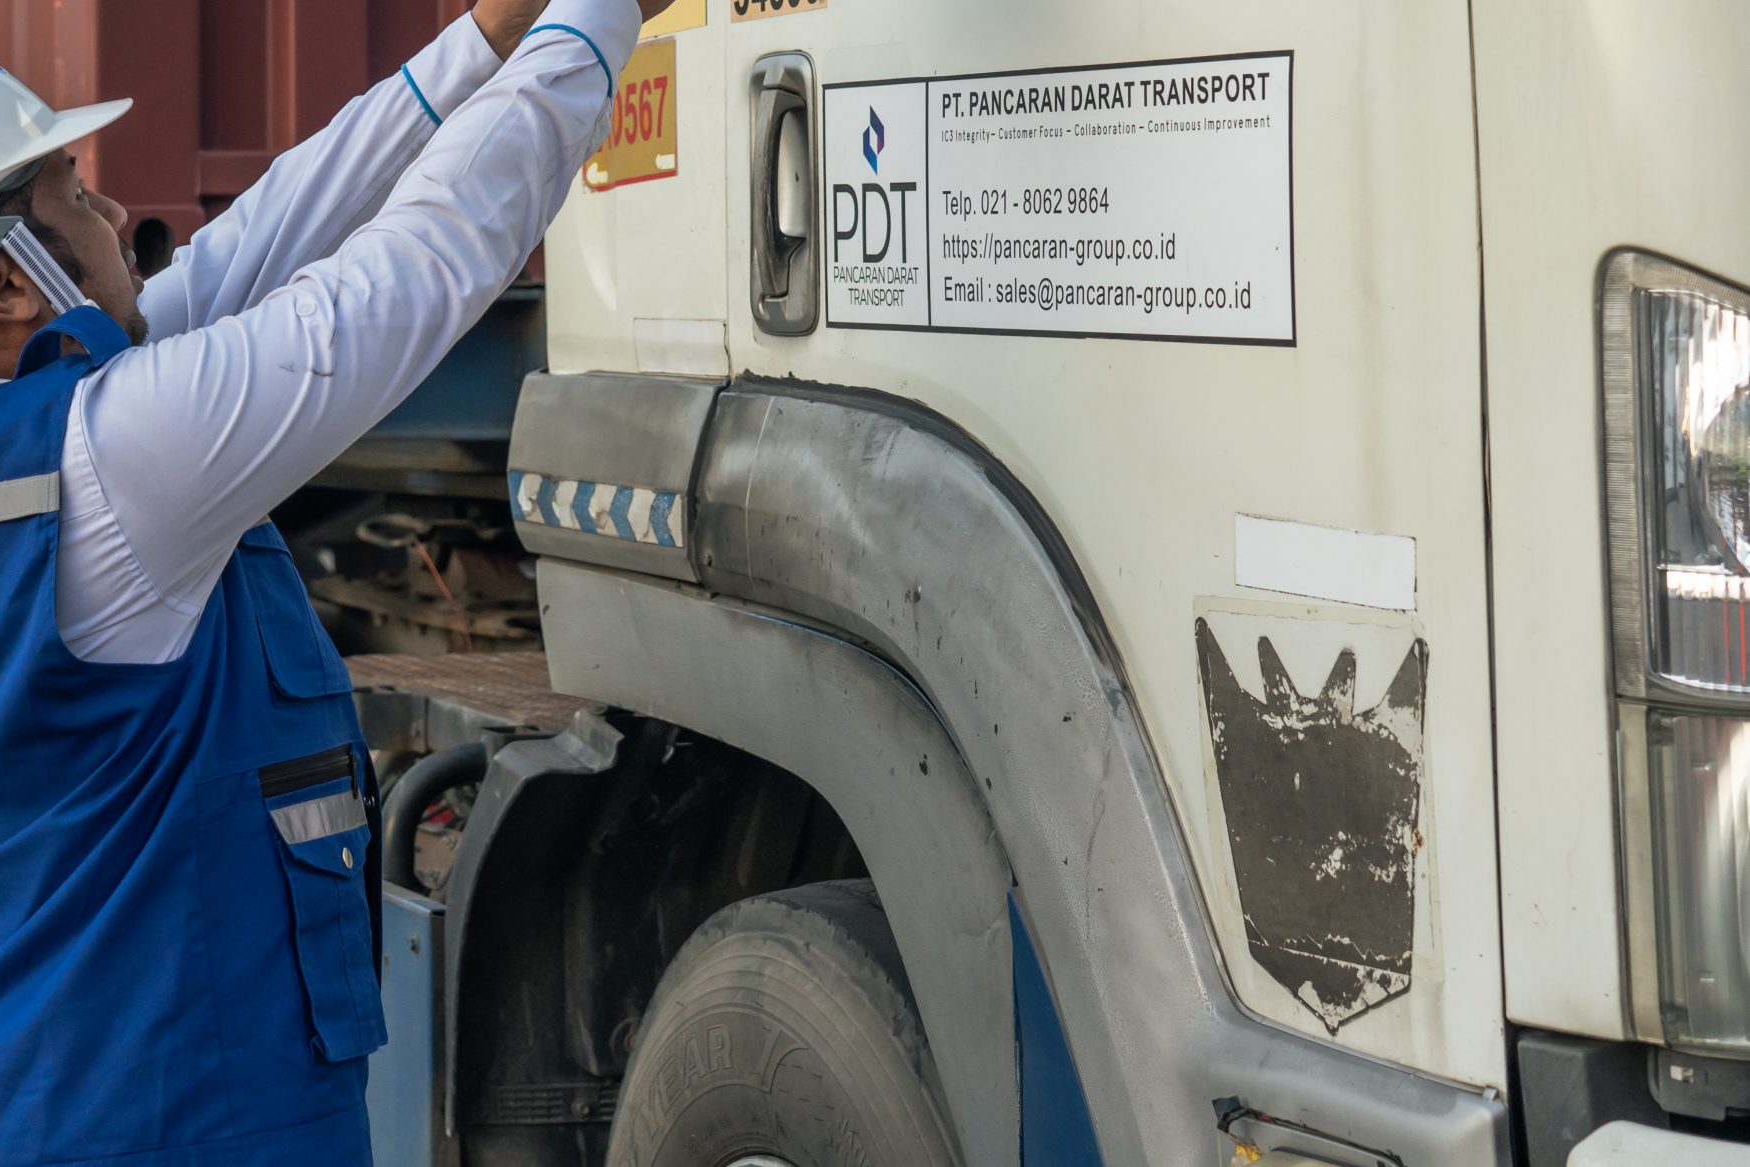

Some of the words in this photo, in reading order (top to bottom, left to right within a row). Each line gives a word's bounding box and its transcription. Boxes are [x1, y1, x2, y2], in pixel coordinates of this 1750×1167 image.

[942, 93, 965, 118] PT.
[969, 86, 1065, 117] PANCARAN
[1071, 82, 1135, 111] DARAT
[1140, 72, 1270, 107] TRANSPORT
[998, 127, 1037, 140] Customer
[1039, 125, 1063, 138] Focus
[1074, 122, 1136, 136] Collaboration
[1148, 119, 1201, 133] Continuous
[1204, 115, 1270, 132] Improvement
[942, 190, 976, 221] Telp.
[981, 189, 1007, 215] 021
[1023, 188, 1063, 215] 8062
[1067, 187, 1109, 214] 9864
[833, 182, 917, 263] PDT
[943, 233, 1176, 266] https://pancaran-group.co.id
[833, 266, 885, 284] PANCARAN
[887, 267, 919, 285] DARAT
[848, 288, 905, 306] TRANSPORT
[944, 276, 983, 302] Email
[996, 277, 1251, 315] sales@pancaran-group.co.id
